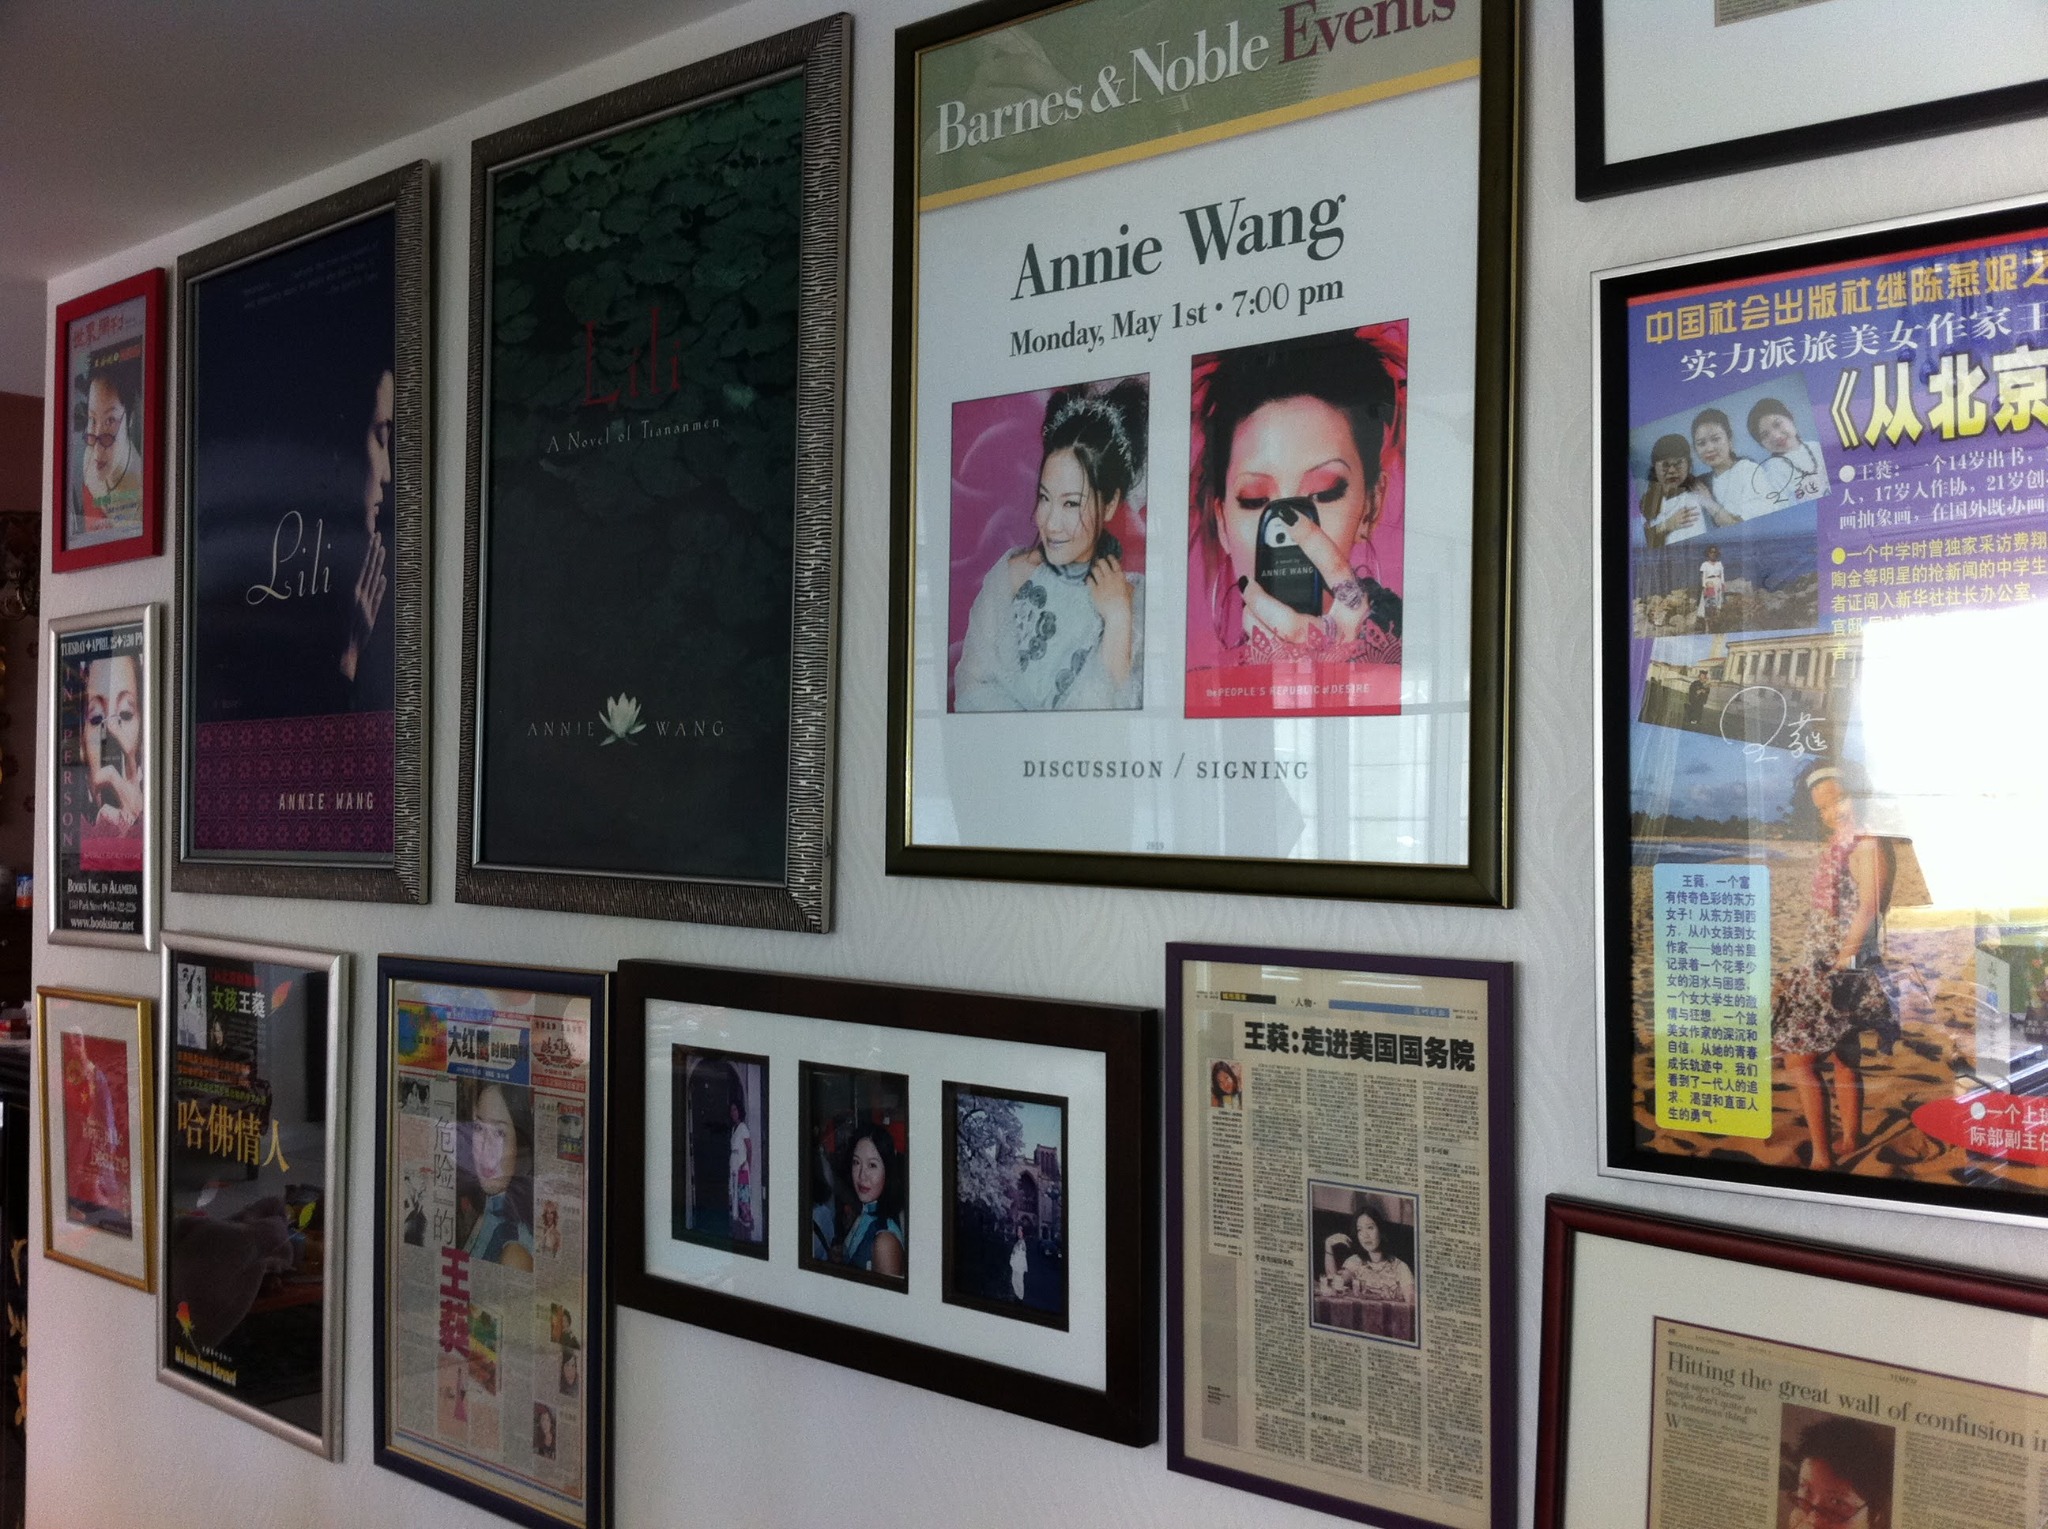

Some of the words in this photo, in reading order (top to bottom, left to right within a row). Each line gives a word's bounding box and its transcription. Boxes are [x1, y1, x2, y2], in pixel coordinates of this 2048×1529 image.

[936, 83, 1083, 155] Barnes
[1090, 65, 1125, 115] &
[1128, 19, 1270, 105] Noble
[1278, 0, 1457, 65] Events
[1010, 224, 1163, 300] Annie
[1179, 193, 1347, 265] Wang
[1009, 319, 1105, 357] Monday,
[1111, 307, 1163, 343] May
[1172, 301, 1208, 329] 1st
[1232, 282, 1290, 318] 7:00
[1298, 279, 1345, 315] pm
[582, 307, 681, 406] Lili
[547, 436, 559, 453] A
[568, 427, 609, 451] Novel
[618, 424, 631, 443] of
[641, 418, 720, 439] Tiananmen
[245, 510, 333, 606] Lili
[1261, 568, 1287, 578] ANNIE
[1290, 566, 1314, 576] WANG
[61, 640, 85, 656] TUESDAY
[91, 637, 109, 652] APRIL
[1270, 684, 1320, 696] REPUBLIC
[1330, 683, 1370, 694] DESIRE
[527, 721, 594, 737] ANNIE
[656, 720, 724, 737] WANG
[1023, 760, 1163, 778] DISCUSSION
[1196, 761, 1309, 780] SIGNING
[279, 793, 325, 811] ANNIE
[336, 792, 374, 810] WANG
[71, 917, 134, 931] www.booksinc.net
[177, 1098, 290, 1173] 哈佛情人
[1666, 1389, 1693, 1401] people
[1696, 1395, 1718, 1405] don't
[1720, 1400, 1742, 1411] quite
[1667, 1376, 1689, 1389] Wang
[1692, 1384, 1709, 1395] says
[1711, 1387, 1746, 1400] Chinese
[1668, 1351, 1735, 1388] Hitting
[1741, 1368, 1773, 1391] the
[1779, 1380, 1831, 1405] great
[1838, 1393, 1880, 1416] wall
[1888, 1402, 1910, 1422] of
[1915, 1413, 2025, 1448] confusion
[1666, 1398, 1679, 1407] the
[1681, 1401, 1722, 1418] American
[1725, 1411, 1747, 1425] thing
